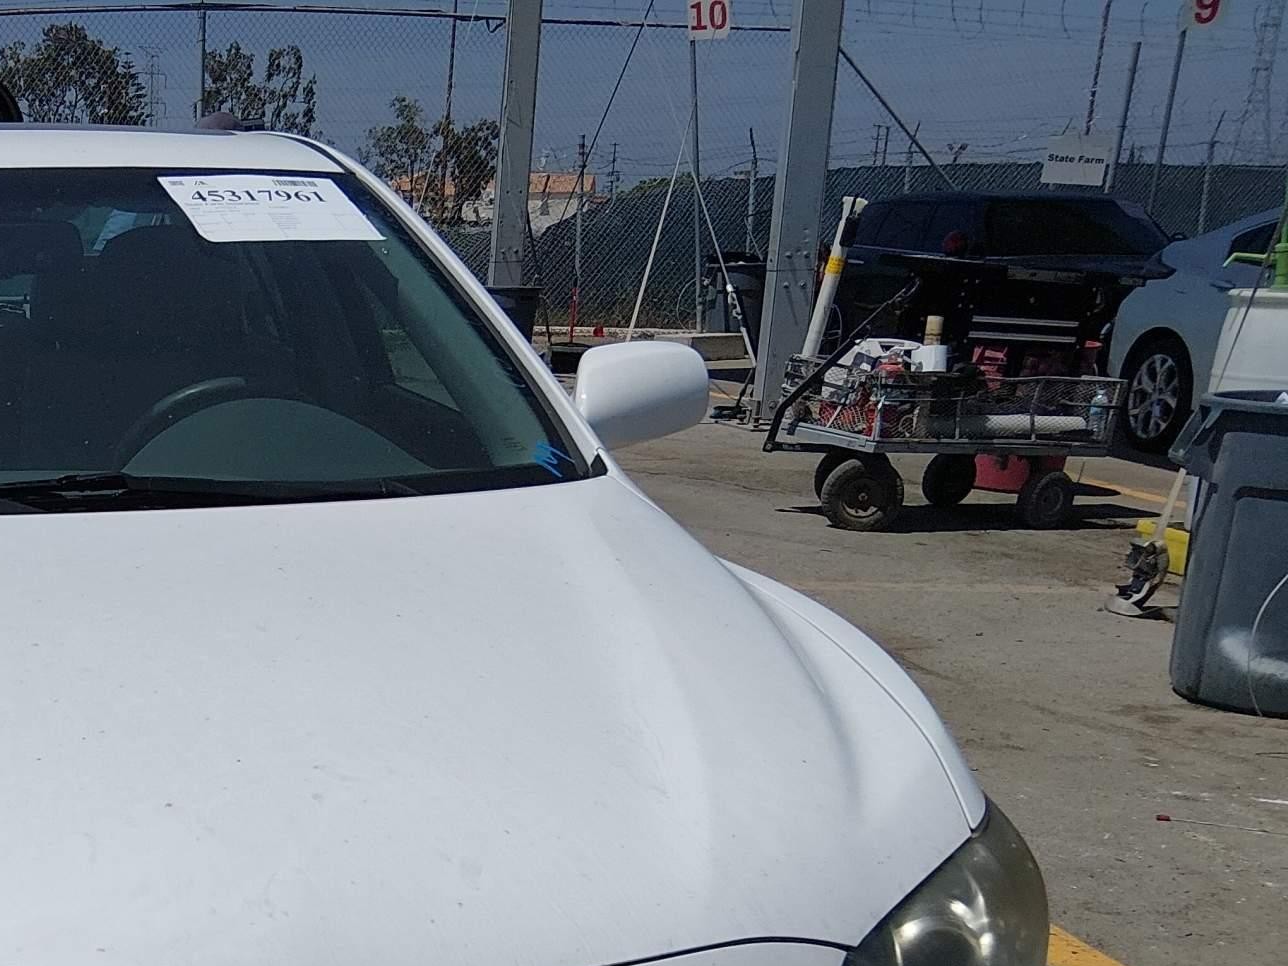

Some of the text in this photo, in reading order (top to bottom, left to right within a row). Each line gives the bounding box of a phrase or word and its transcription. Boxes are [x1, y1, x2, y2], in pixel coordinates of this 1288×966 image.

[690, 0, 727, 30] 10
[1194, 0, 1220, 24] 9
[1047, 153, 1105, 164] State Farm
[191, 190, 327, 203] 45317961
